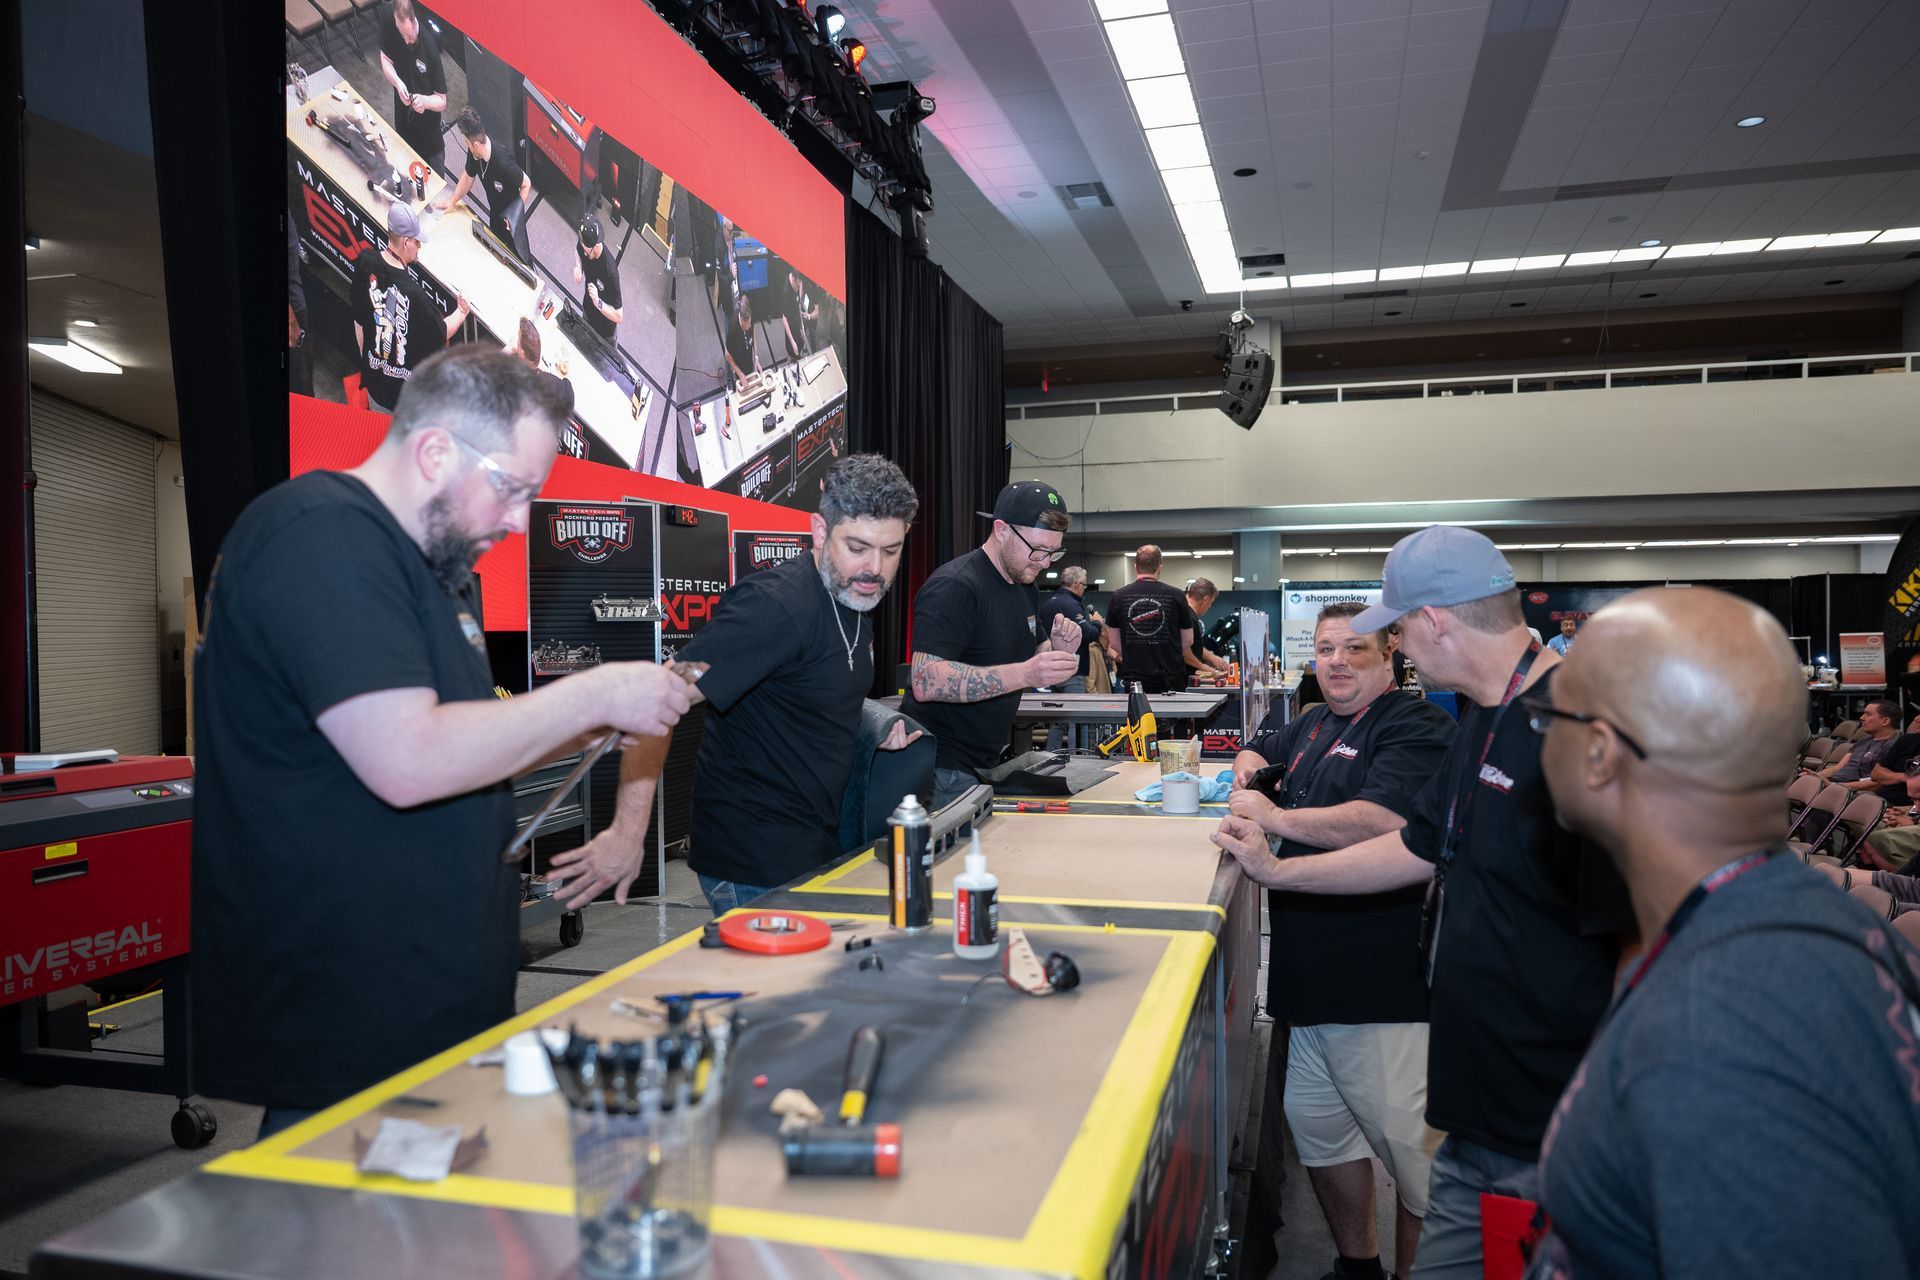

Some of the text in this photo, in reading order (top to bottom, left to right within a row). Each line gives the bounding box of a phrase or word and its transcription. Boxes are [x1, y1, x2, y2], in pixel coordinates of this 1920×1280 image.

[797, 403, 845, 441] MASTERTECH
[555, 520, 628, 543] BUILD OFF
[577, 551, 607, 561] CHALLENGE
[753, 546, 803, 563] BUILD OFF
[660, 578, 727, 593] STERTECH
[1305, 594, 1368, 603] shopmonkey
[1551, 611, 1595, 622] ELEVAT
[1203, 735, 1243, 751] EX
[0, 921, 162, 982] IVERSAL
[52, 942, 162, 982] SYSTEMS
